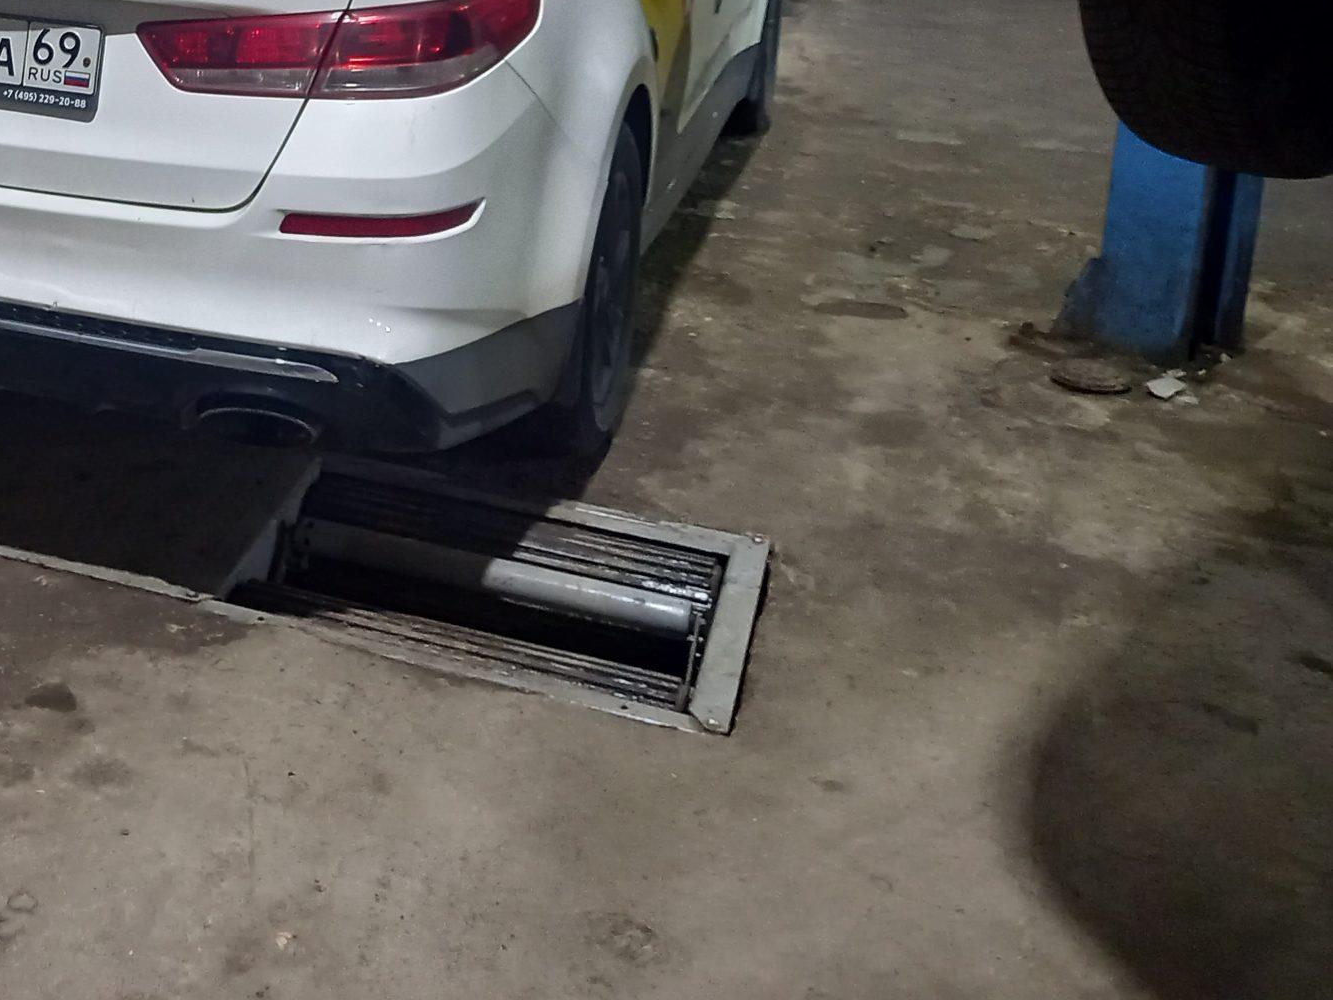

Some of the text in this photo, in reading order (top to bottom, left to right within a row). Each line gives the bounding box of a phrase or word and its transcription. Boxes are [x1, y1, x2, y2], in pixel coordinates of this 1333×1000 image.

[32, 28, 82, 69] 69
[27, 66, 63, 85] RUS
[2, 88, 87, 109] +7 (495) 229-20-88
